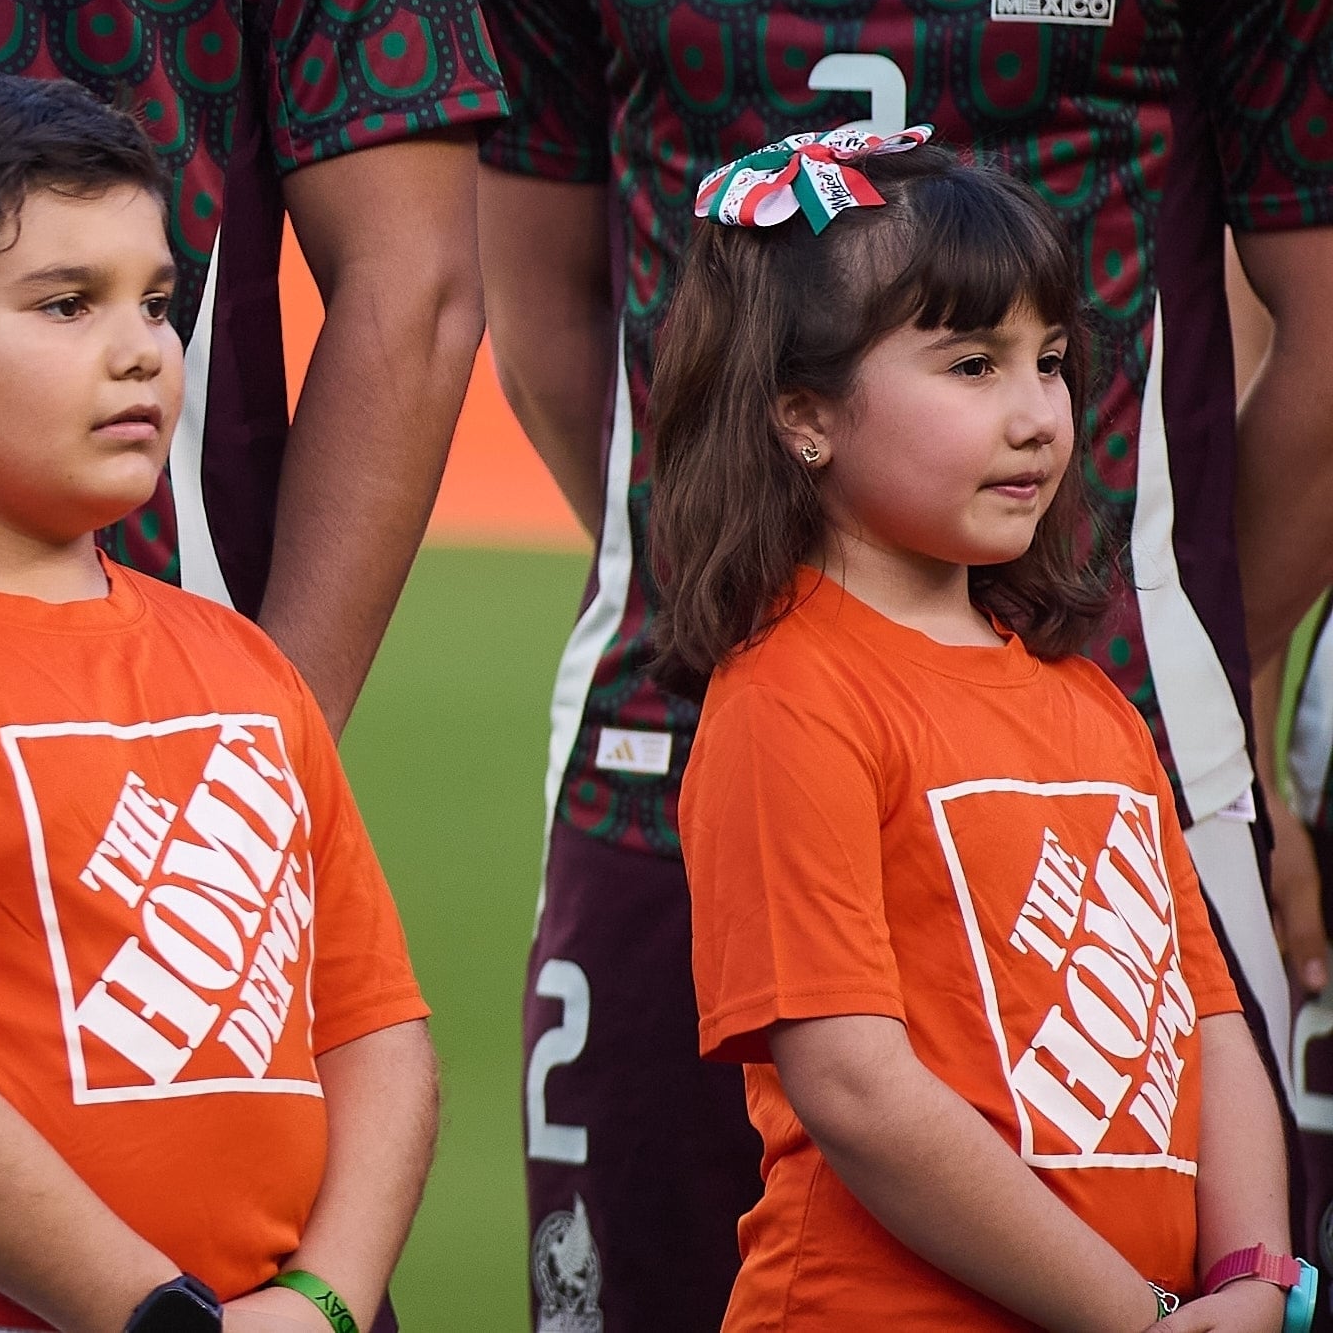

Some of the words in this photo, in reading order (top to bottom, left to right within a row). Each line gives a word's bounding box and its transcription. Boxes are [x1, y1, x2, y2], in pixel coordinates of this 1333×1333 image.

[74, 724, 303, 1086] HOME
[79, 770, 179, 909] THE
[1009, 826, 1088, 972] THE
[217, 851, 312, 1079] DEPOT
[526, 958, 590, 1165] 2
[1011, 795, 1171, 1154] HOME
[1128, 953, 1197, 1154] DEPO
